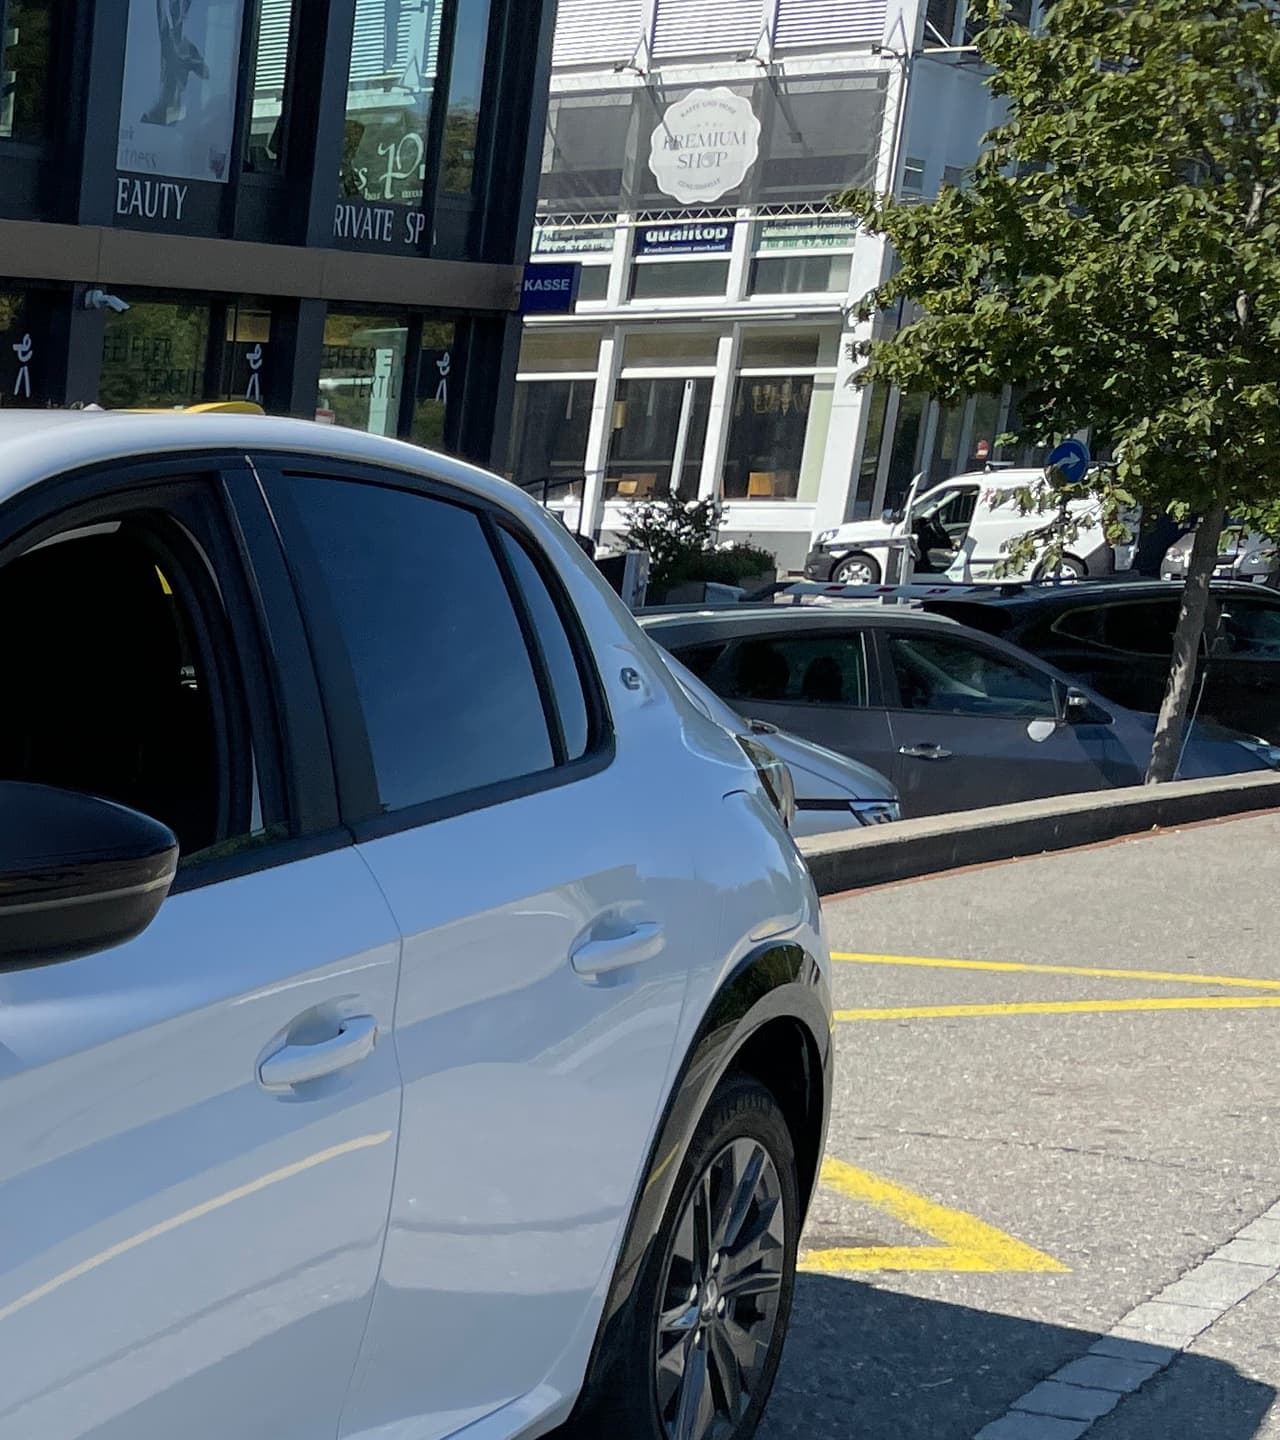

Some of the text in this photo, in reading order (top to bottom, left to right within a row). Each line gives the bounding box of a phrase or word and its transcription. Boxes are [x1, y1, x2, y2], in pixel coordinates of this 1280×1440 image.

[662, 129, 747, 151] PREMIUM
[676, 151, 729, 170] SHOP
[116, 178, 188, 220] EAUTY
[404, 212, 437, 246] SP
[645, 224, 728, 245] qualitop
[523, 278, 571, 291] KASSE
